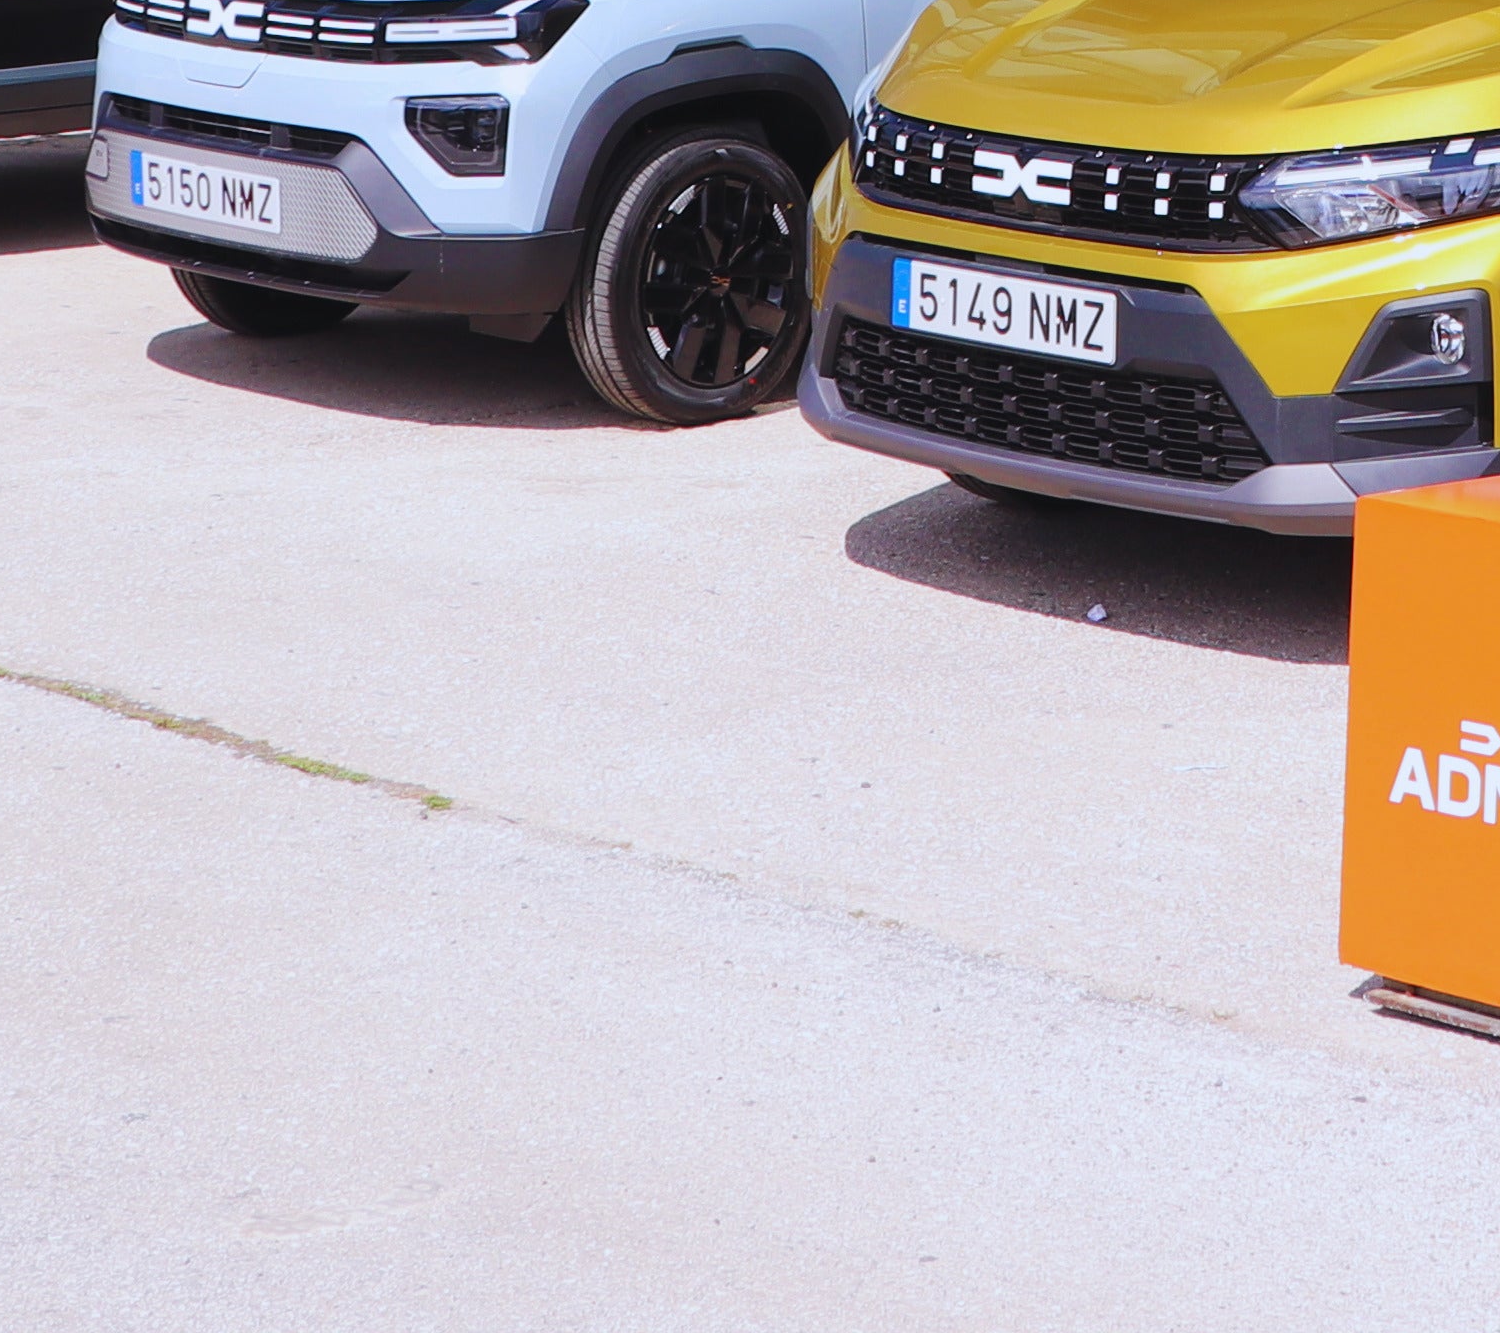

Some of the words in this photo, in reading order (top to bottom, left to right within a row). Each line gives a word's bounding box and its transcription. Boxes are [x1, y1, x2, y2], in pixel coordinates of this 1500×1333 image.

[147, 161, 212, 211] 5150
[221, 175, 273, 224] NMZ
[919, 272, 1013, 334] 5149
[1029, 291, 1105, 351] NMZ
